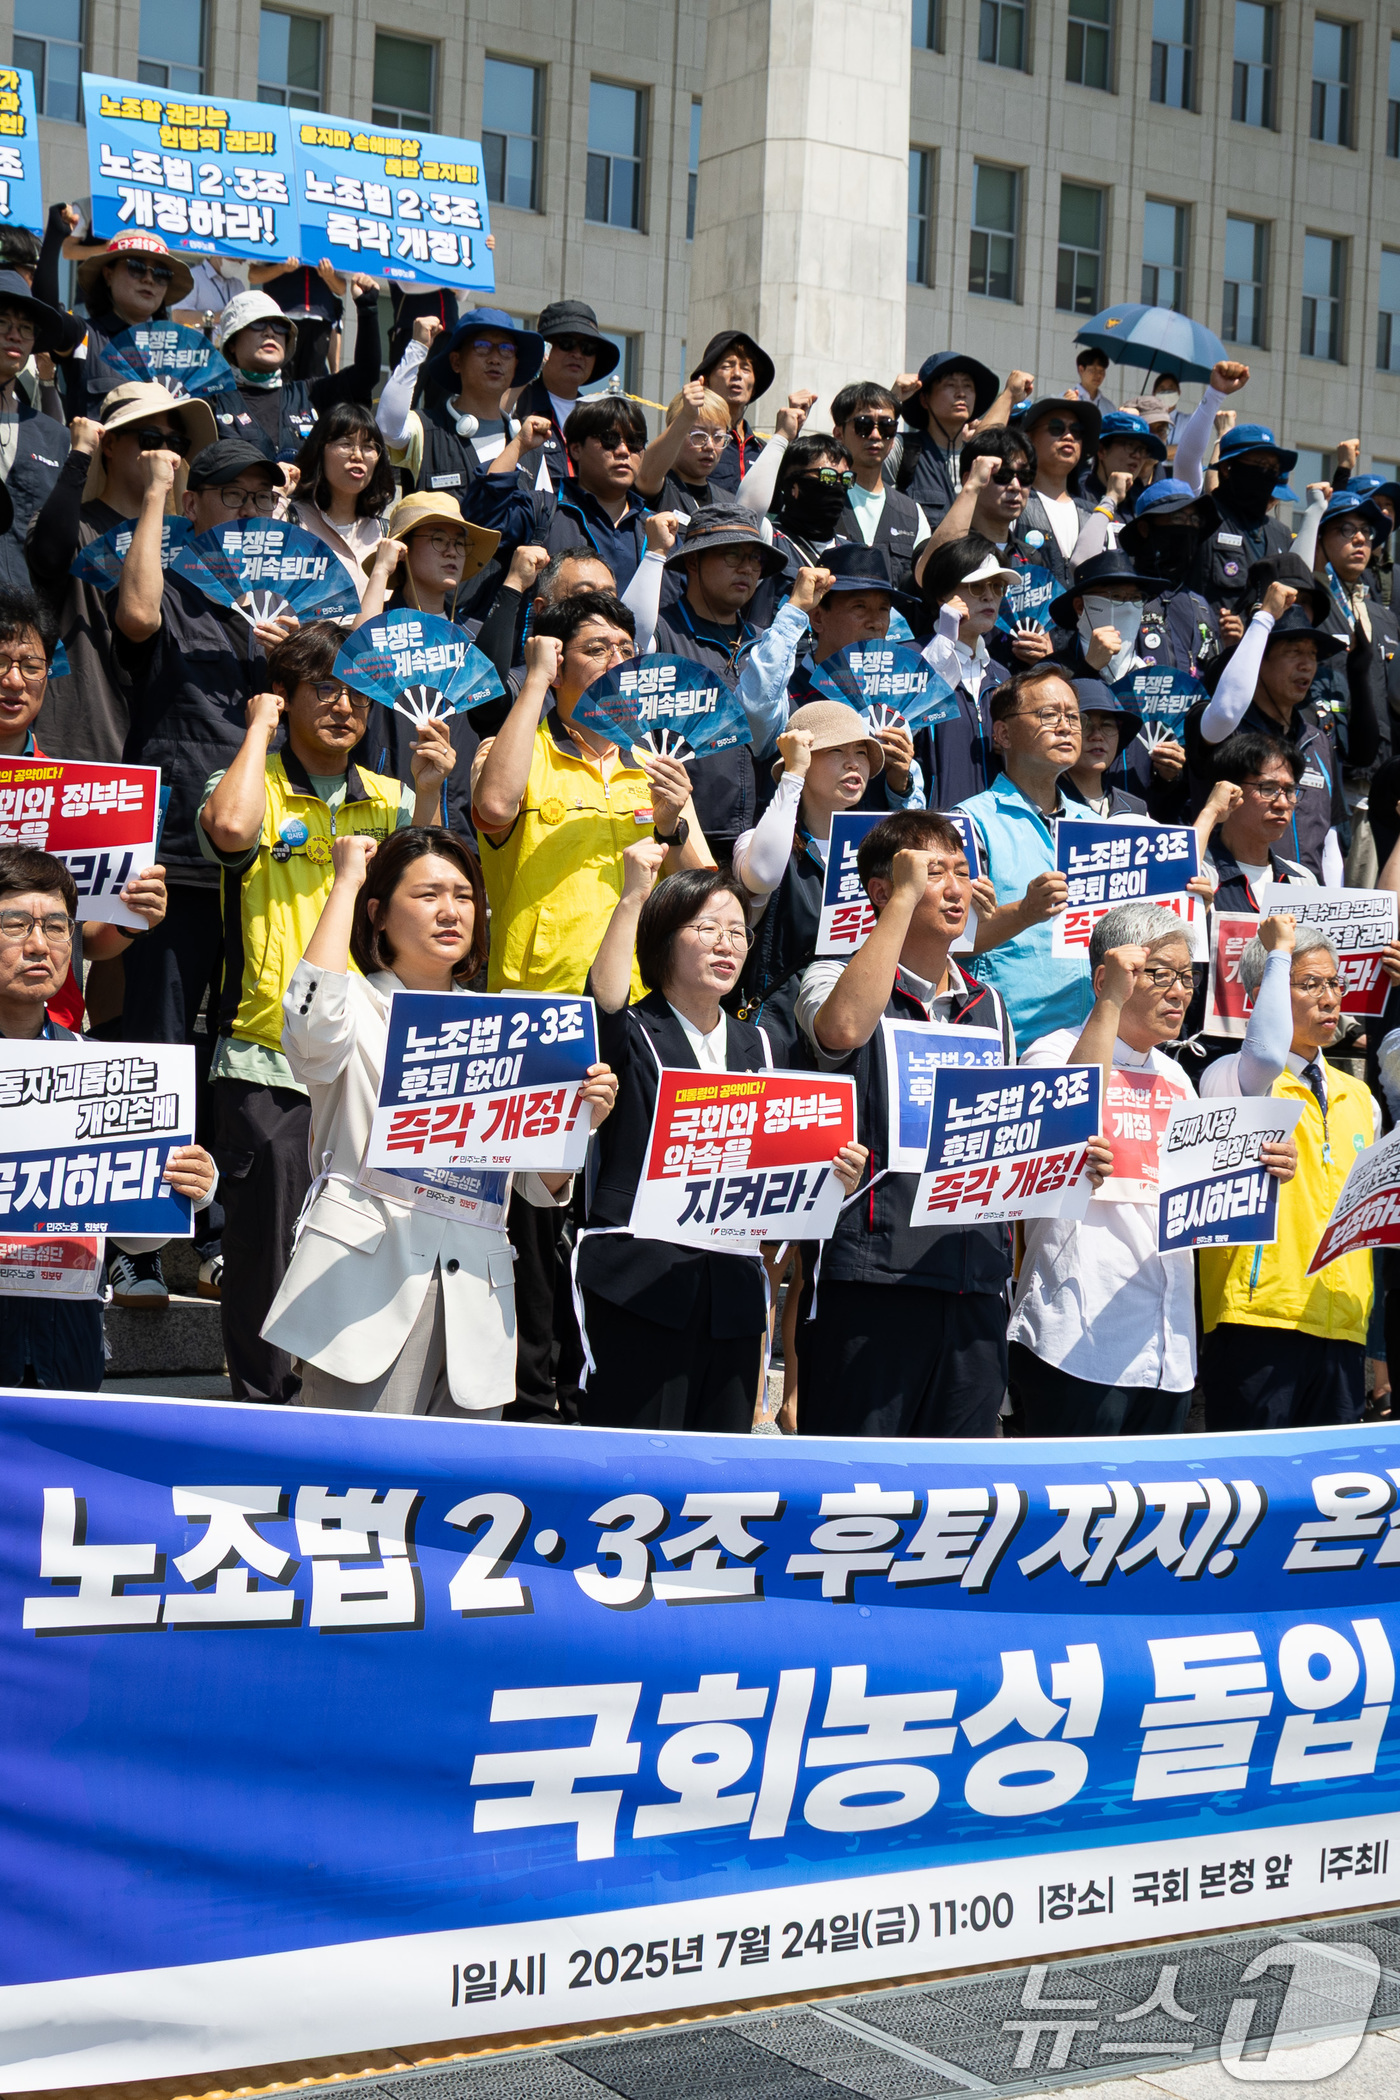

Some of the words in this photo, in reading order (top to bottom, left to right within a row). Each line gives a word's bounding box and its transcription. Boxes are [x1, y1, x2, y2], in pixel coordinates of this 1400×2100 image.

[100, 94, 162, 122] 노조할
[165, 103, 229, 128] 권리는
[159, 125, 221, 151] 헌법적
[224, 130, 276, 155] 권리!
[353, 133, 421, 157] 손해배상
[99, 144, 195, 193] 노조법
[198, 163, 290, 204] 2·3조
[422, 161, 479, 185] 금지법!
[117, 186, 279, 246] 개정하라!
[305, 170, 393, 218] 노조법
[397, 188, 482, 230] 2·3조
[327, 212, 391, 257] 즉각
[396, 226, 475, 269] 개정!
[135, 330, 179, 350] 투쟁은
[147, 349, 210, 369] 계속된다!
[222, 530, 284, 555] 투쟁은
[239, 556, 328, 581] 계속된다!
[1010, 581, 1053, 613] 계속된다!
[370, 621, 424, 653] 투쟁은
[849, 651, 894, 674] 투쟁은
[619, 665, 677, 696] 투쟁은
[863, 672, 929, 696] 계속된다!
[1132, 675, 1174, 695] 투쟁은
[637, 687, 719, 721] 계속된다!
[13, 766, 64, 782] 공약이다!
[60, 779, 144, 818] 정부는
[1067, 838, 1132, 876] 노조법
[1134, 830, 1190, 866] 2·3조
[1065, 875, 1106, 906] 후퇴
[1108, 868, 1147, 900] 없이
[1358, 921, 1394, 948] 권리!
[402, 1014, 503, 1063] 노조법
[507, 1003, 585, 1049] 2·3조
[53, 1057, 158, 1103] 괴롭히는
[398, 1062, 460, 1101] 후퇴
[463, 1053, 523, 1093] 없이
[675, 1086, 718, 1103] 대통령의
[719, 1081, 767, 1100] 공약이다!
[944, 1084, 1025, 1132] 노조법
[1028, 1070, 1090, 1115] 2·3조
[1106, 1086, 1152, 1109] 온전한
[75, 1093, 179, 1139] 개인손배
[386, 1102, 476, 1154] 즉각
[480, 1087, 584, 1143] 개정!
[669, 1101, 758, 1142] 국회와
[763, 1093, 843, 1134] 정부는
[1112, 1112, 1153, 1142] 개정
[1167, 1115, 1203, 1152] 진짜
[1200, 1107, 1237, 1143] 사장
[460, 1156, 487, 1164] 민주노총
[491, 1155, 512, 1164] 진보당
[662, 1137, 752, 1178] 약속을
[940, 1129, 990, 1167] 후퇴
[992, 1119, 1042, 1157] 없이
[1212, 1135, 1246, 1171] 원청
[423, 1167, 481, 1194] 국회농성단
[676, 1167, 830, 1227] 지켜라!
[926, 1165, 1001, 1213] 즉각
[1001, 1150, 1089, 1201] 개정!
[426, 1189, 456, 1205] 민주노총
[459, 1199, 478, 1211] 진보당
[1165, 1171, 1272, 1240] 명시하라!
[46, 1222, 79, 1232] 민주노총
[84, 1222, 109, 1233] 진보당
[720, 1228, 746, 1236] 민주노총
[750, 1228, 768, 1236] 진보당
[40, 1271, 63, 1281] 진보당
[23, 1485, 424, 1634] 노조법
[444, 1490, 785, 1614] 2·3조
[785, 1482, 1022, 1602] 후퇴
[1017, 1477, 1266, 1583] 저지!
[1282, 1467, 1400, 1572] 온
[470, 1642, 1104, 1862] 국회농성
[1132, 1617, 1396, 1801] 돌입
[568, 1932, 704, 1990] 2025년
[716, 1924, 771, 1969] 7월
[781, 1902, 921, 1960] 24일(금)
[929, 1891, 1015, 1938] 11:00
[1132, 1866, 1190, 1908] 국회
[1199, 1858, 1256, 1898] 본청
[1265, 1852, 1293, 1890] 앞
